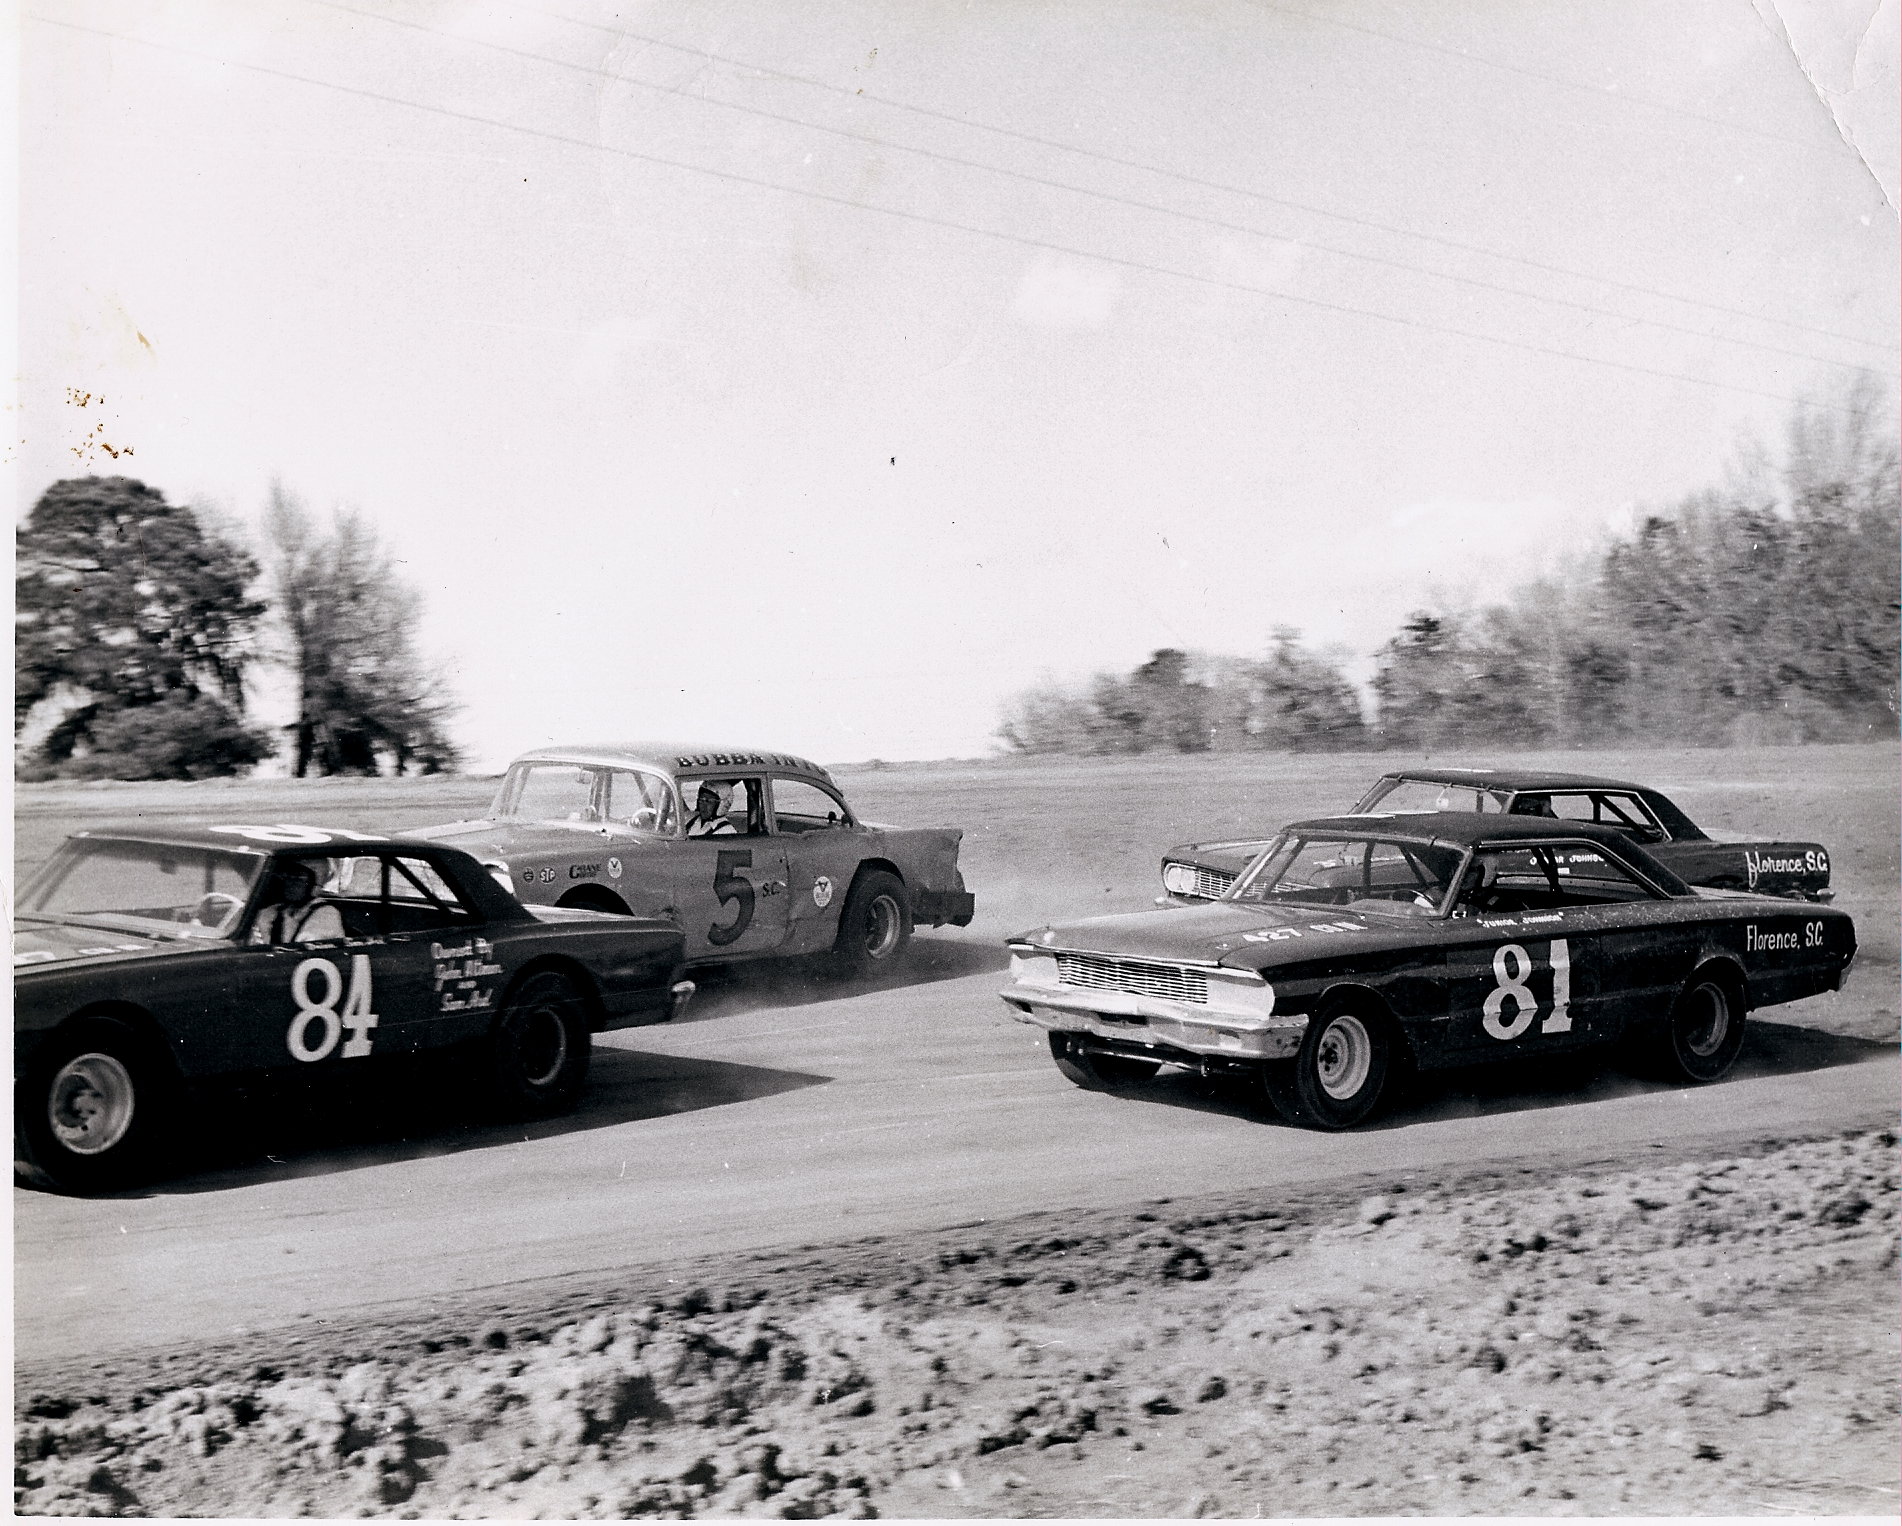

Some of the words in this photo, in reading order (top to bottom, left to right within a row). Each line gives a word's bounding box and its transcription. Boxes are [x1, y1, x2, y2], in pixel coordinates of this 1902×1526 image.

[674, 753, 766, 767] BUBBA
[540, 868, 556, 881] STP
[707, 849, 755, 946] 5
[1242, 928, 1303, 942] 427
[1746, 924, 1801, 952] Florence,
[1805, 920, 1824, 947] S.C.
[1482, 938, 1573, 1040] 81
[286, 953, 380, 1062] 84
